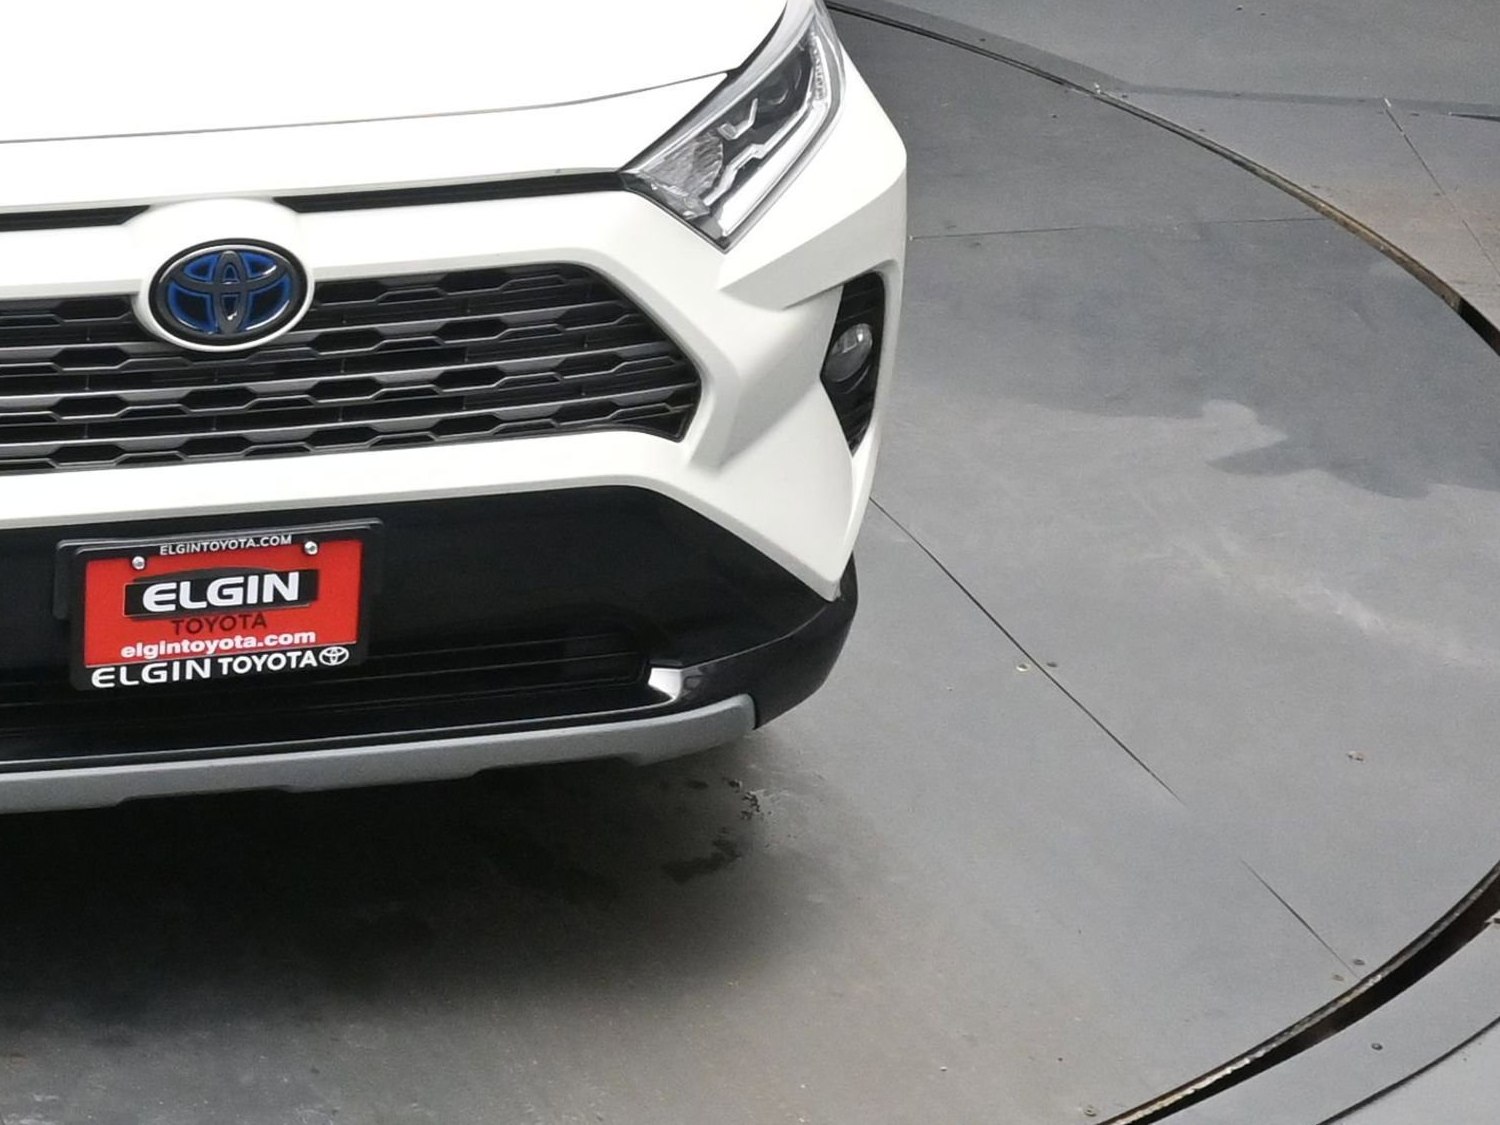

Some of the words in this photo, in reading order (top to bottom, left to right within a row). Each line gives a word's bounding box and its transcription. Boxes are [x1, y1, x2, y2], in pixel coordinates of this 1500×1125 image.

[159, 535, 292, 555] ELGINTOYOTA.COM
[142, 572, 299, 612] ELGIN
[171, 613, 267, 635] TOYOTA
[120, 631, 316, 659] elgintoyota.com
[91, 658, 211, 688] ELGIN
[218, 650, 317, 675] TOYOTA
